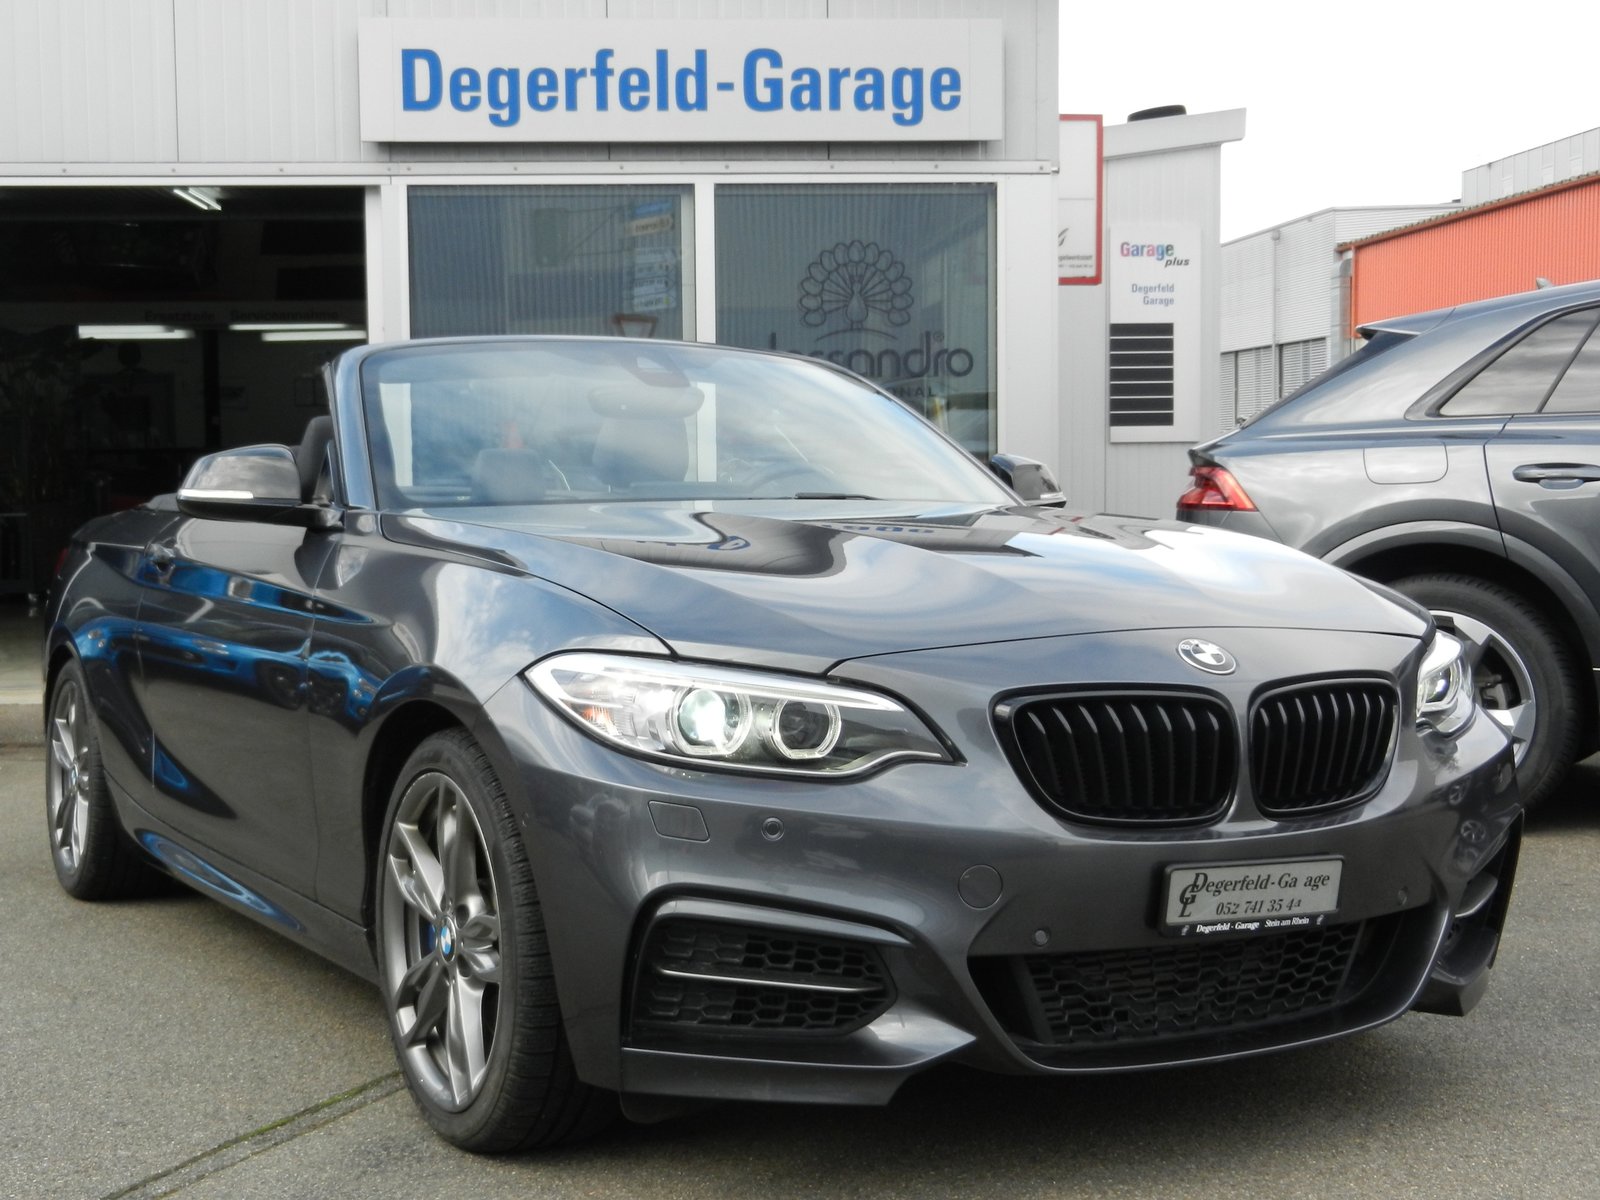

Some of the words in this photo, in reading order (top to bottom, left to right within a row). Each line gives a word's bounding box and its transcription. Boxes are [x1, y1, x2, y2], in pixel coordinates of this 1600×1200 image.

[401, 48, 962, 127] Degerfeld-Garage
[1120, 241, 1175, 261] Garage
[1164, 257, 1190, 268] plus
[1131, 283, 1175, 295] Degerfeld
[1143, 296, 1175, 307] Garage
[1192, 872, 1330, 897] Degerfeld-Gaage
[1216, 902, 1239, 915] 052
[1244, 900, 1264, 913] 741
[1267, 898, 1284, 912] 35
[1196, 923, 1231, 934] Degerfeld
[1235, 921, 1260, 931] Garage
[1264, 919, 1281, 928] Stein
[1292, 917, 1310, 925] Rhein
